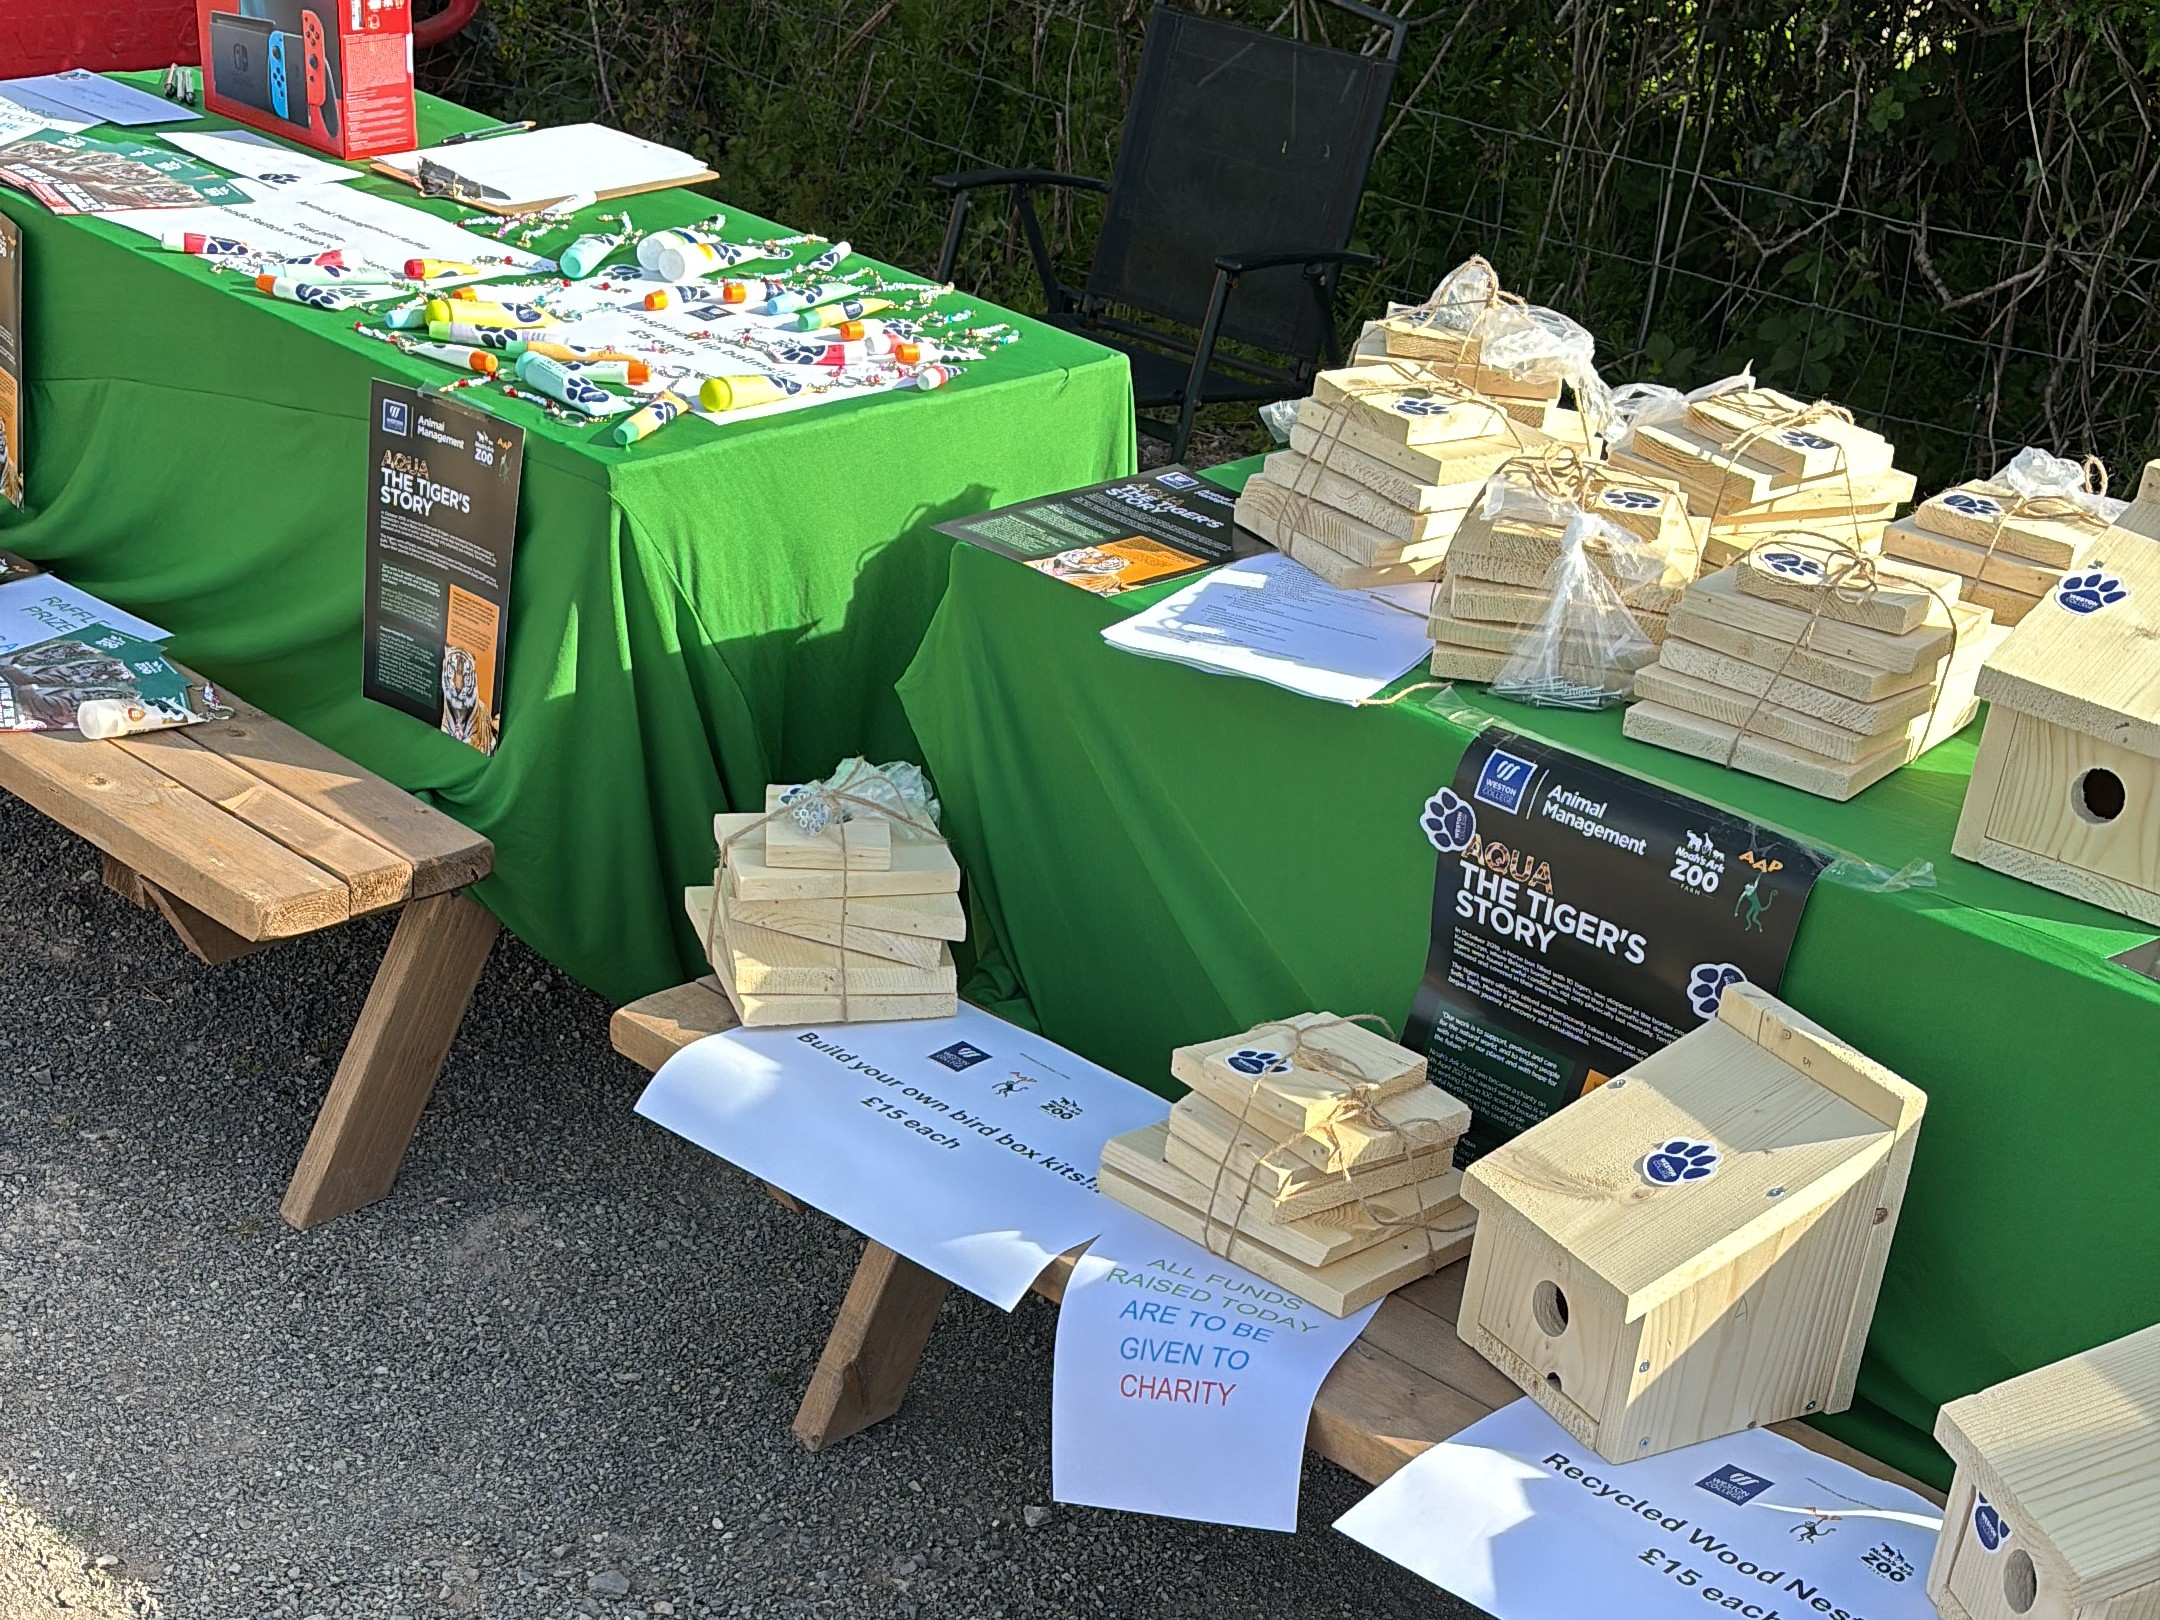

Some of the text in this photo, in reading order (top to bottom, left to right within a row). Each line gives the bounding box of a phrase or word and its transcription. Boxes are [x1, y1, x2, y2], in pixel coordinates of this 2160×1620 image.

[417, 425, 464, 450] Management
[418, 415, 445, 431] Animal
[380, 449, 430, 479] AQUA
[474, 448, 494, 466] ZOO
[380, 486, 434, 516] STORY
[381, 467, 471, 513] THE TIGER'S
[1106, 488, 1168, 514] STORY
[1121, 484, 1158, 504] THE
[1156, 501, 1225, 529] TIGER'S
[20, 606, 78, 632] PRIZE
[1482, 786, 1513, 805] COLLEGE
[1486, 778, 1517, 796] WESTON
[1547, 784, 1608, 819] Animal
[1455, 811, 1463, 839] WESTON
[1542, 800, 1648, 856] Management
[1460, 833, 1554, 895] AQUA
[1670, 858, 1719, 893] ZOO
[1675, 846, 1725, 874] Noah's Ark
[1738, 850, 1784, 873] AAP
[1680, 884, 1701, 896] FARM
[1455, 889, 1558, 954] STORY
[1459, 859, 1647, 964] THE TIGER'S
[1461, 930, 1485, 945] October
[1451, 962, 1462, 970] The
[1480, 993, 1503, 1006] journey
[1510, 1007, 1536, 1022] recovery
[1536, 1018, 1549, 1027] and
[1448, 1023, 1458, 1032] the
[1459, 1028, 1479, 1042] natural
[1498, 1047, 1510, 1056] and
[1518, 1056, 1538, 1071] inspire
[1538, 1065, 1559, 1080] people
[1455, 1017, 1470, 1029] work
[1508, 1042, 1530, 1058] protect
[1530, 1053, 1542, 1063] and
[1543, 1060, 1556, 1069] care
[1454, 1035, 1467, 1044] love
[1485, 1049, 1504, 1063] planet
[1504, 1058, 1516, 1067] and
[1531, 1071, 1547, 1083] hope
[1547, 1078, 1557, 1087] for
[796, 1031, 859, 1063] Build
[849, 1061, 905, 1087] your
[901, 1086, 950, 1112] own
[947, 1109, 1001, 1137] bird
[994, 1133, 1042, 1161] box
[1039, 1103, 1074, 1120] ZOO
[860, 1095, 961, 1151] £15 each
[1106, 1267, 1320, 1333] RAISED TODAY
[1147, 1258, 1303, 1310] ALL FUNDS
[1119, 1299, 1274, 1343] ARE TO BE
[1120, 1336, 1250, 1370] GIVEN TO
[1119, 1373, 1237, 1407] CHARITY
[1705, 1480, 1745, 1502] COLLEGE
[1711, 1477, 1750, 1497] WESTON
[1542, 1452, 1689, 1532] Recycled
[1688, 1527, 1785, 1584] Wood
[1637, 1547, 1704, 1586] £15
[1859, 1554, 1906, 1583] ZOO
